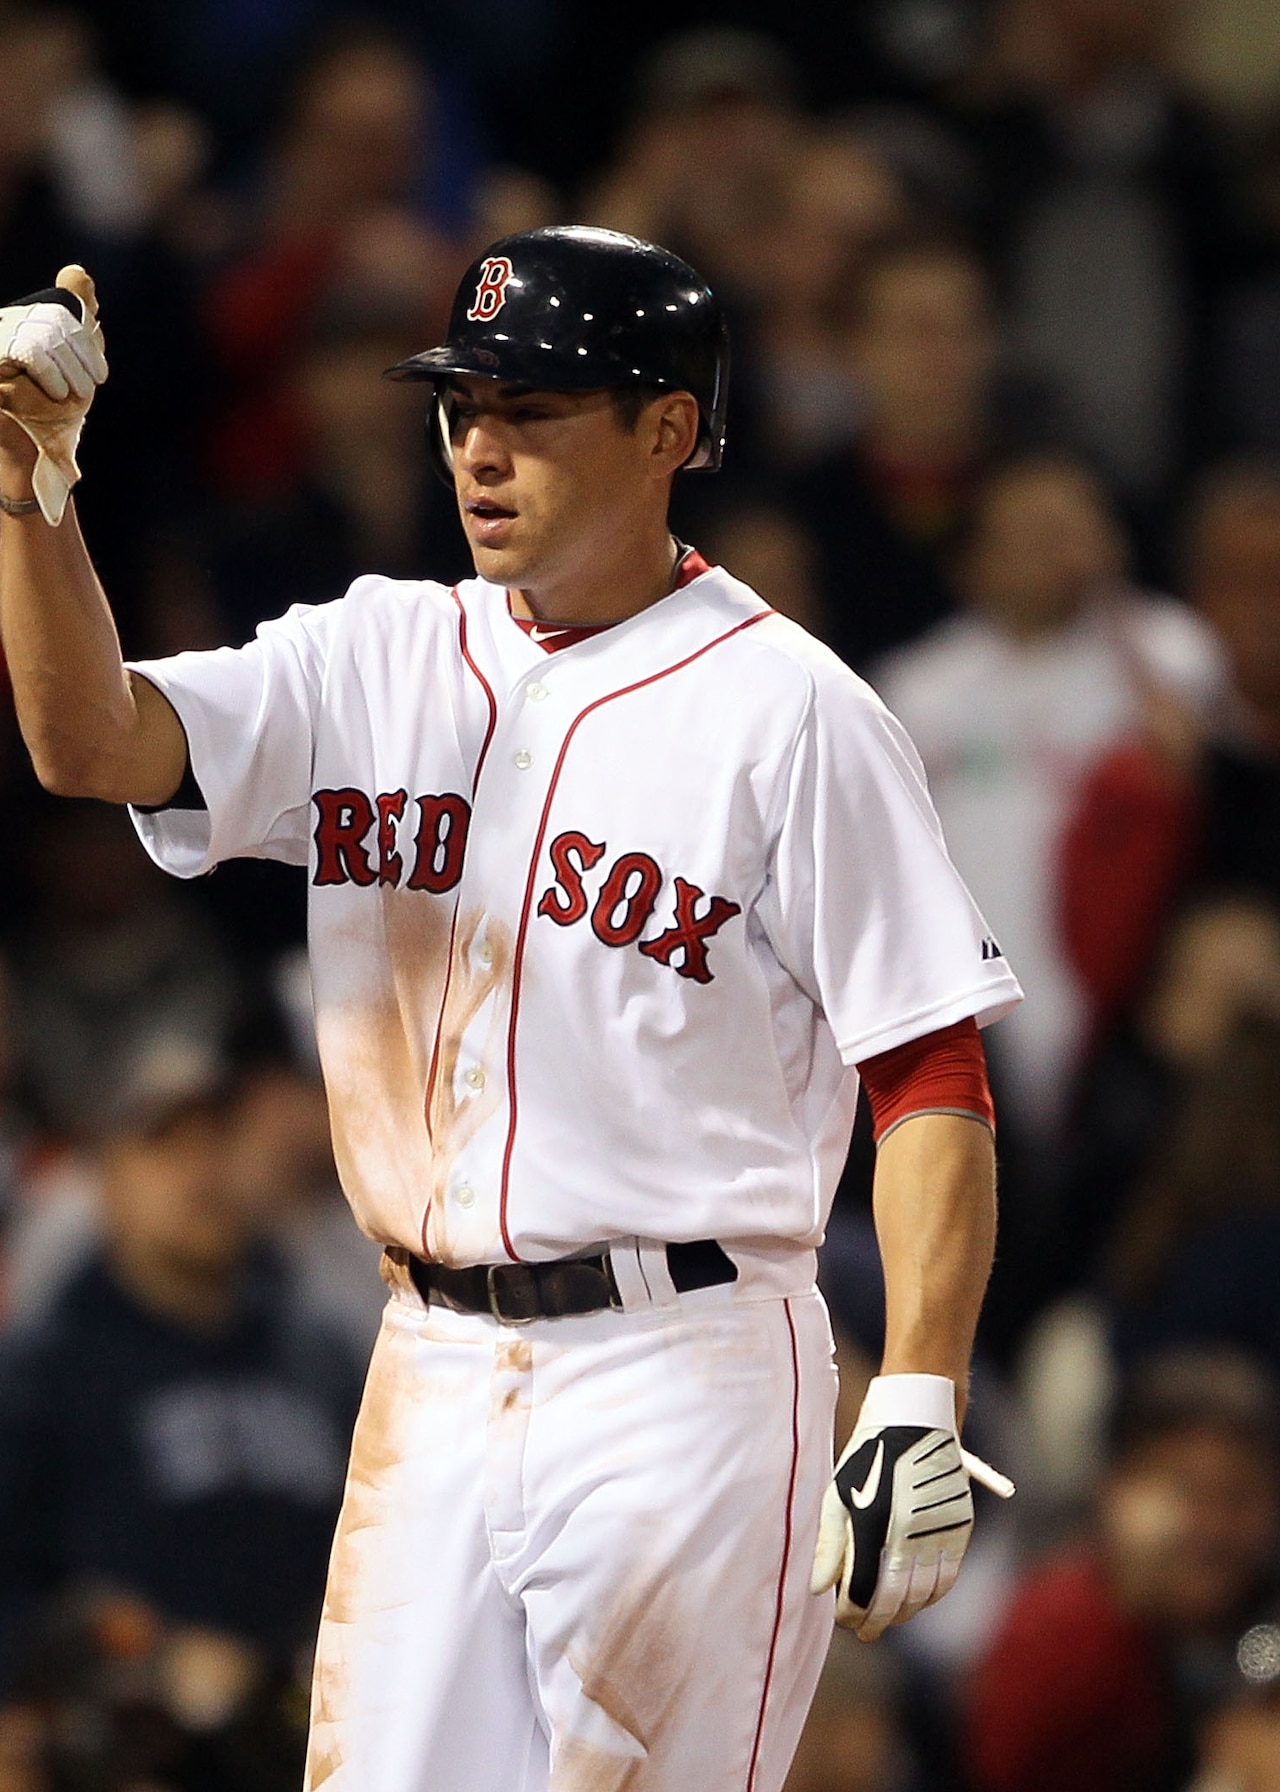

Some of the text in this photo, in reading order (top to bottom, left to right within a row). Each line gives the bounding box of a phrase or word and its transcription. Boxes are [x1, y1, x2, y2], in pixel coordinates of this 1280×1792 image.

[467, 257, 515, 322] B
[312, 787, 742, 985] RED SOX
